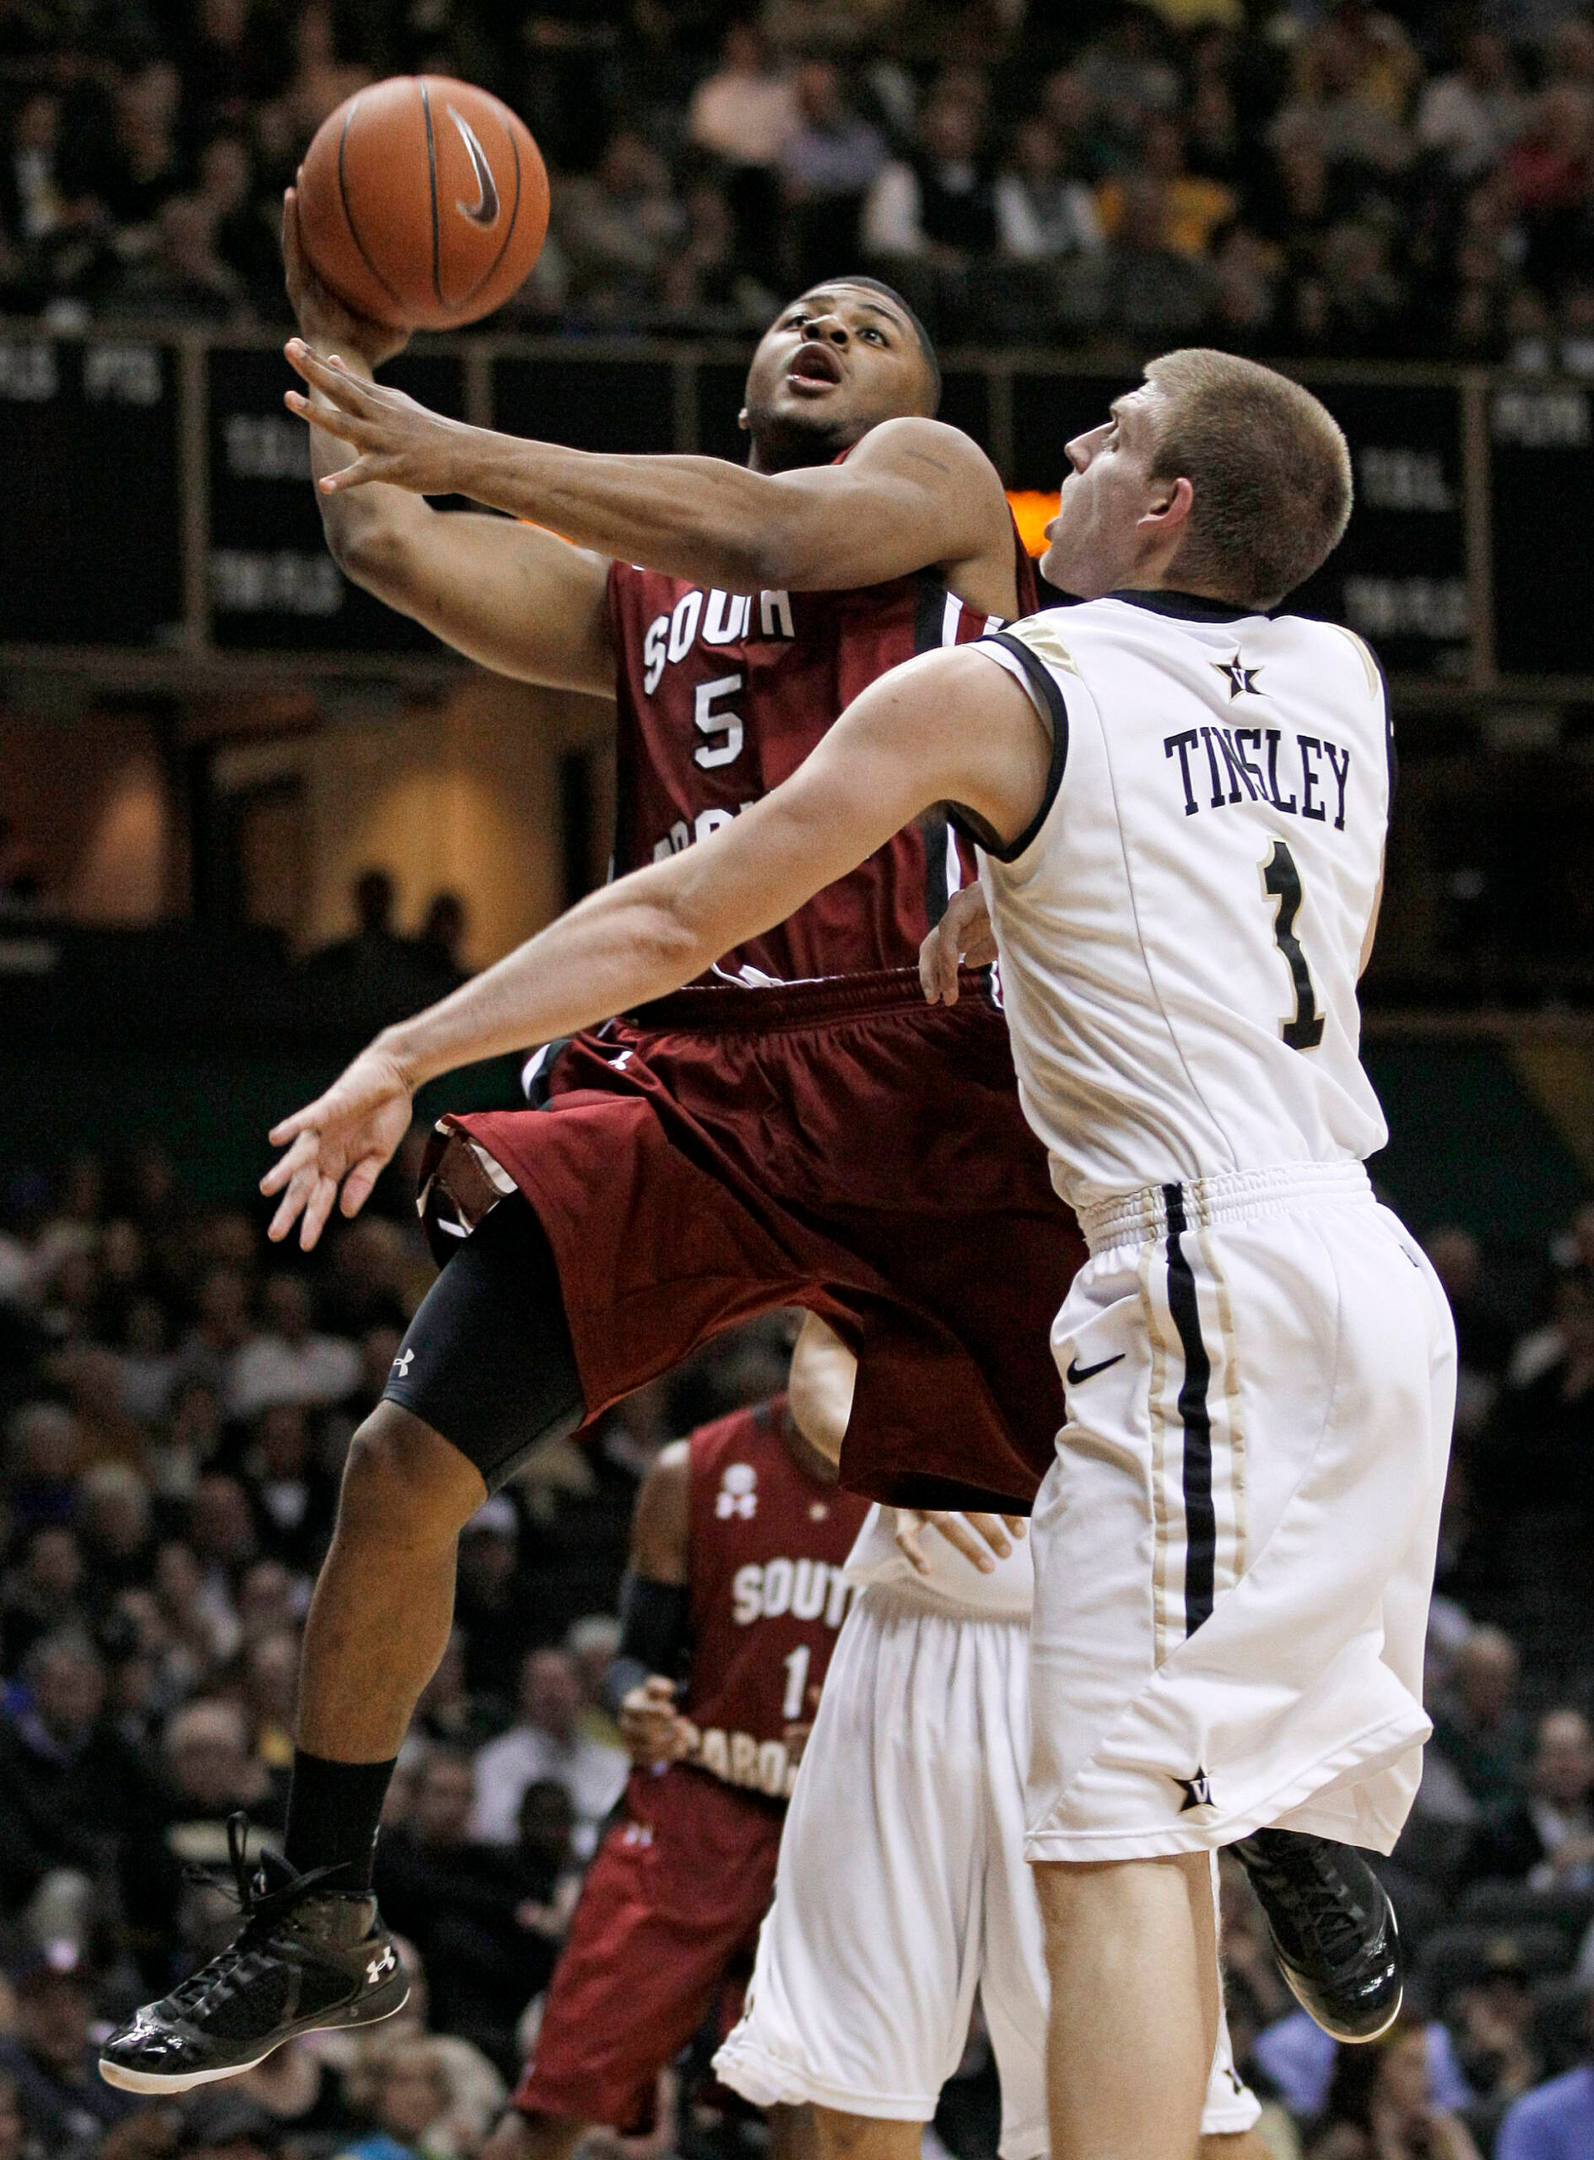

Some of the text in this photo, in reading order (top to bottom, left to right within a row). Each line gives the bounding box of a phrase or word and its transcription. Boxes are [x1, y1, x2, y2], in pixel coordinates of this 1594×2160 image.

[693, 673, 744, 770] 5
[1164, 726, 1350, 832] TINSLEY
[1257, 835, 1326, 1053] 1
[733, 1556, 858, 1629] SOUT
[783, 1644, 811, 1720] 1
[690, 1727, 800, 1797] ARO
